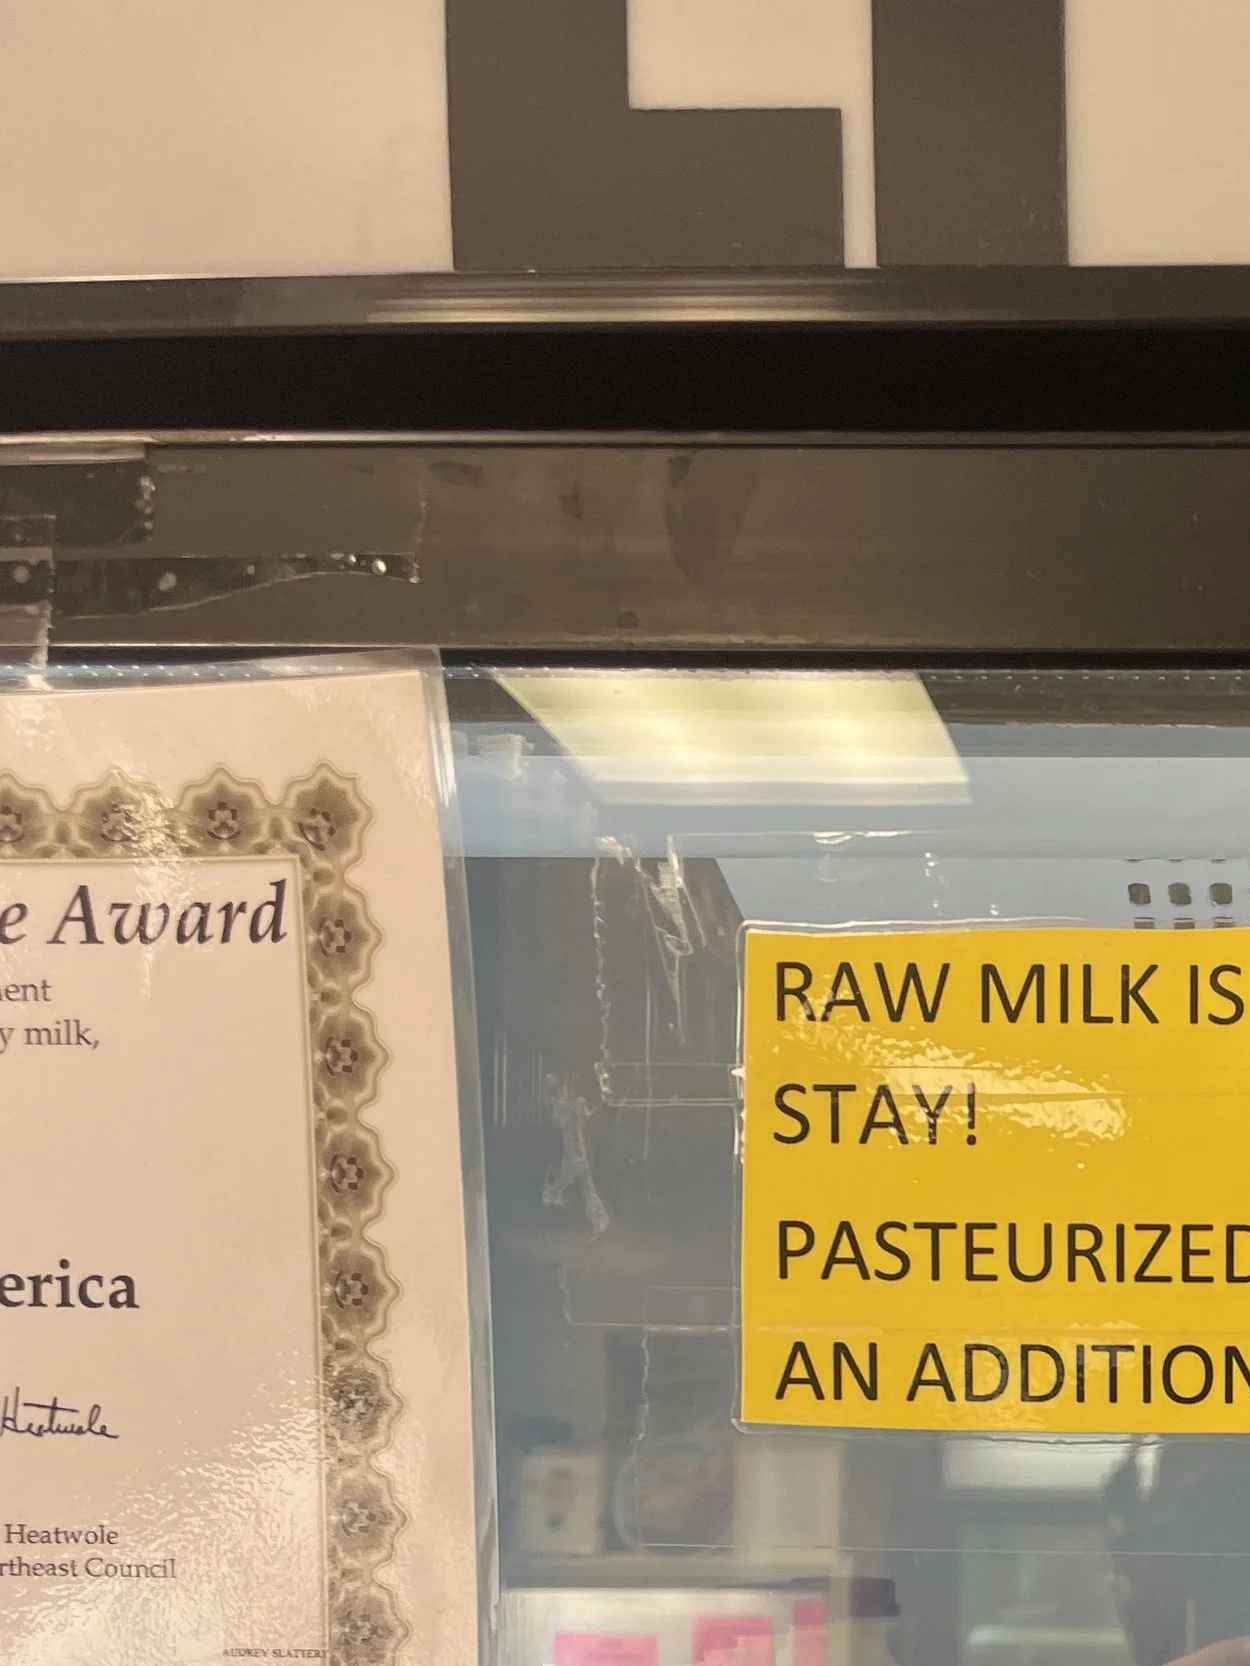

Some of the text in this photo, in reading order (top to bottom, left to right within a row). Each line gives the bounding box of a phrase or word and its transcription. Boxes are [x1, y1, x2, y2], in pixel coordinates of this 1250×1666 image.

[46, 878, 288, 945] Award
[0, 978, 52, 1003] ent
[775, 961, 951, 1024] RAW
[980, 963, 1160, 1025] MILK
[1188, 963, 1246, 1026] IS
[24, 1019, 100, 1051] milk,
[773, 1083, 978, 1146] STAY!
[775, 1341, 878, 1402] AN
[4, 1522, 119, 1545] Heatwole
[84, 1557, 177, 1579] Council
[222, 1648, 269, 1658] AUDREY
